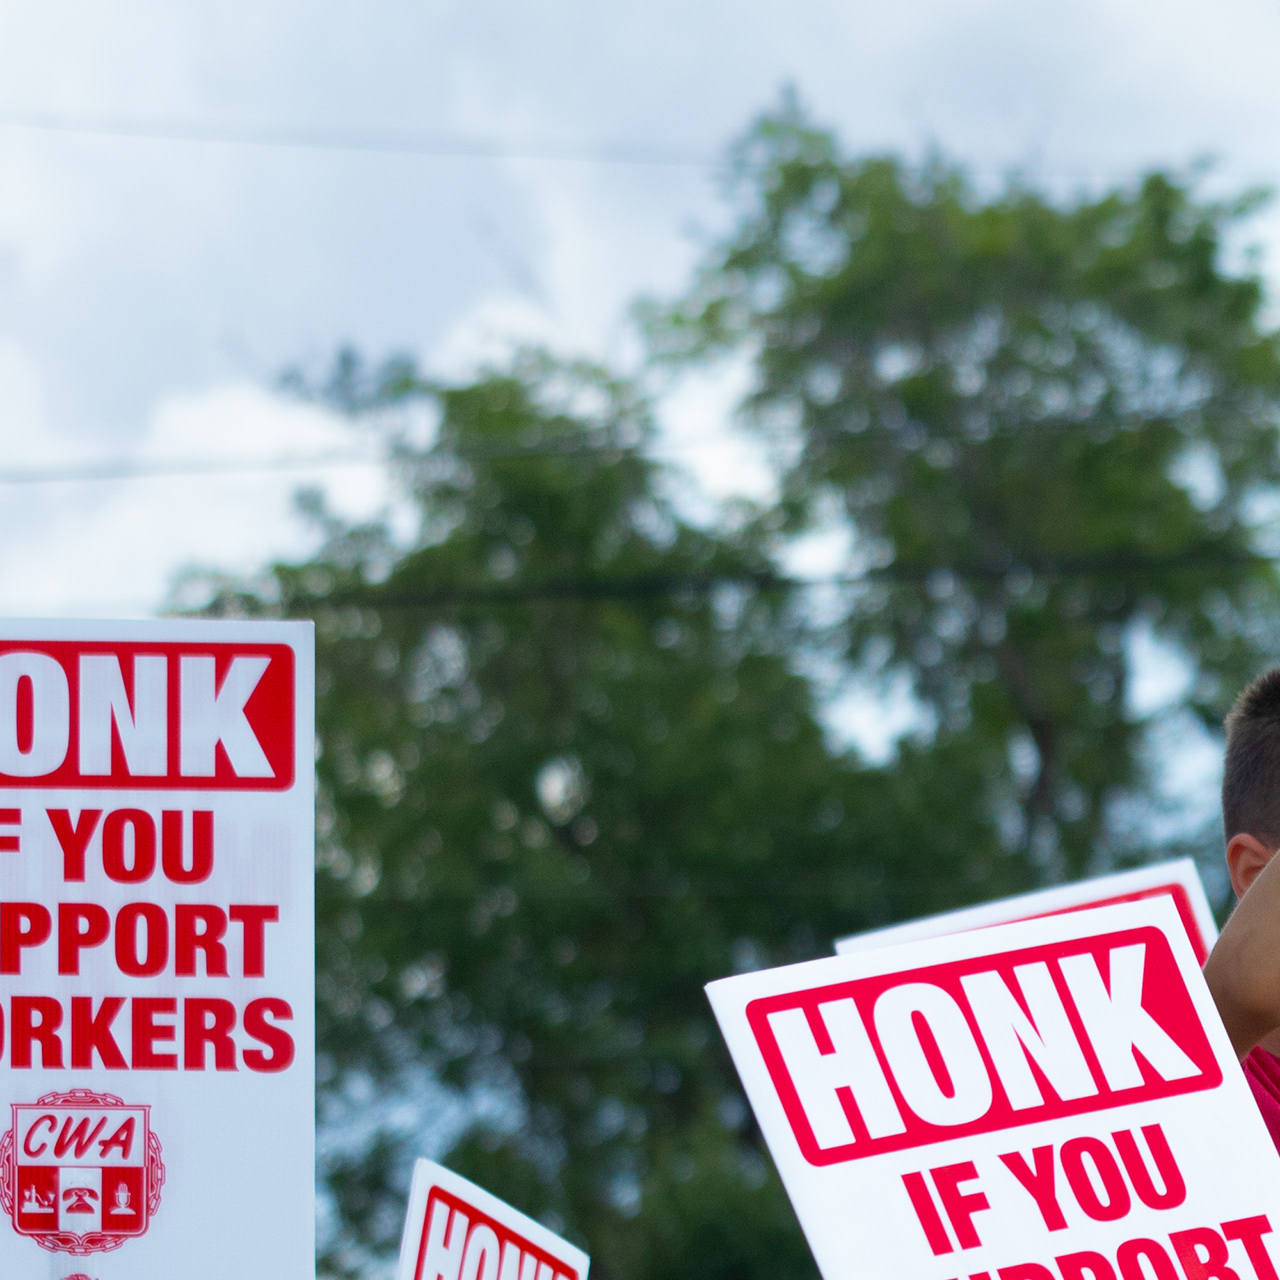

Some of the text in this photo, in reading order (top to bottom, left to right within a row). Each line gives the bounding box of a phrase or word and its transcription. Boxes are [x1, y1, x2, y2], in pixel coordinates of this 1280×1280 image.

[0, 653, 275, 777] ONK
[46, 808, 214, 884] YOU
[0, 902, 279, 978] PPORT
[0, 996, 294, 1072] RKERS
[767, 943, 1202, 1149] HONK
[23, 1114, 134, 1160] CWA
[901, 1123, 1187, 1256] IF YOU
